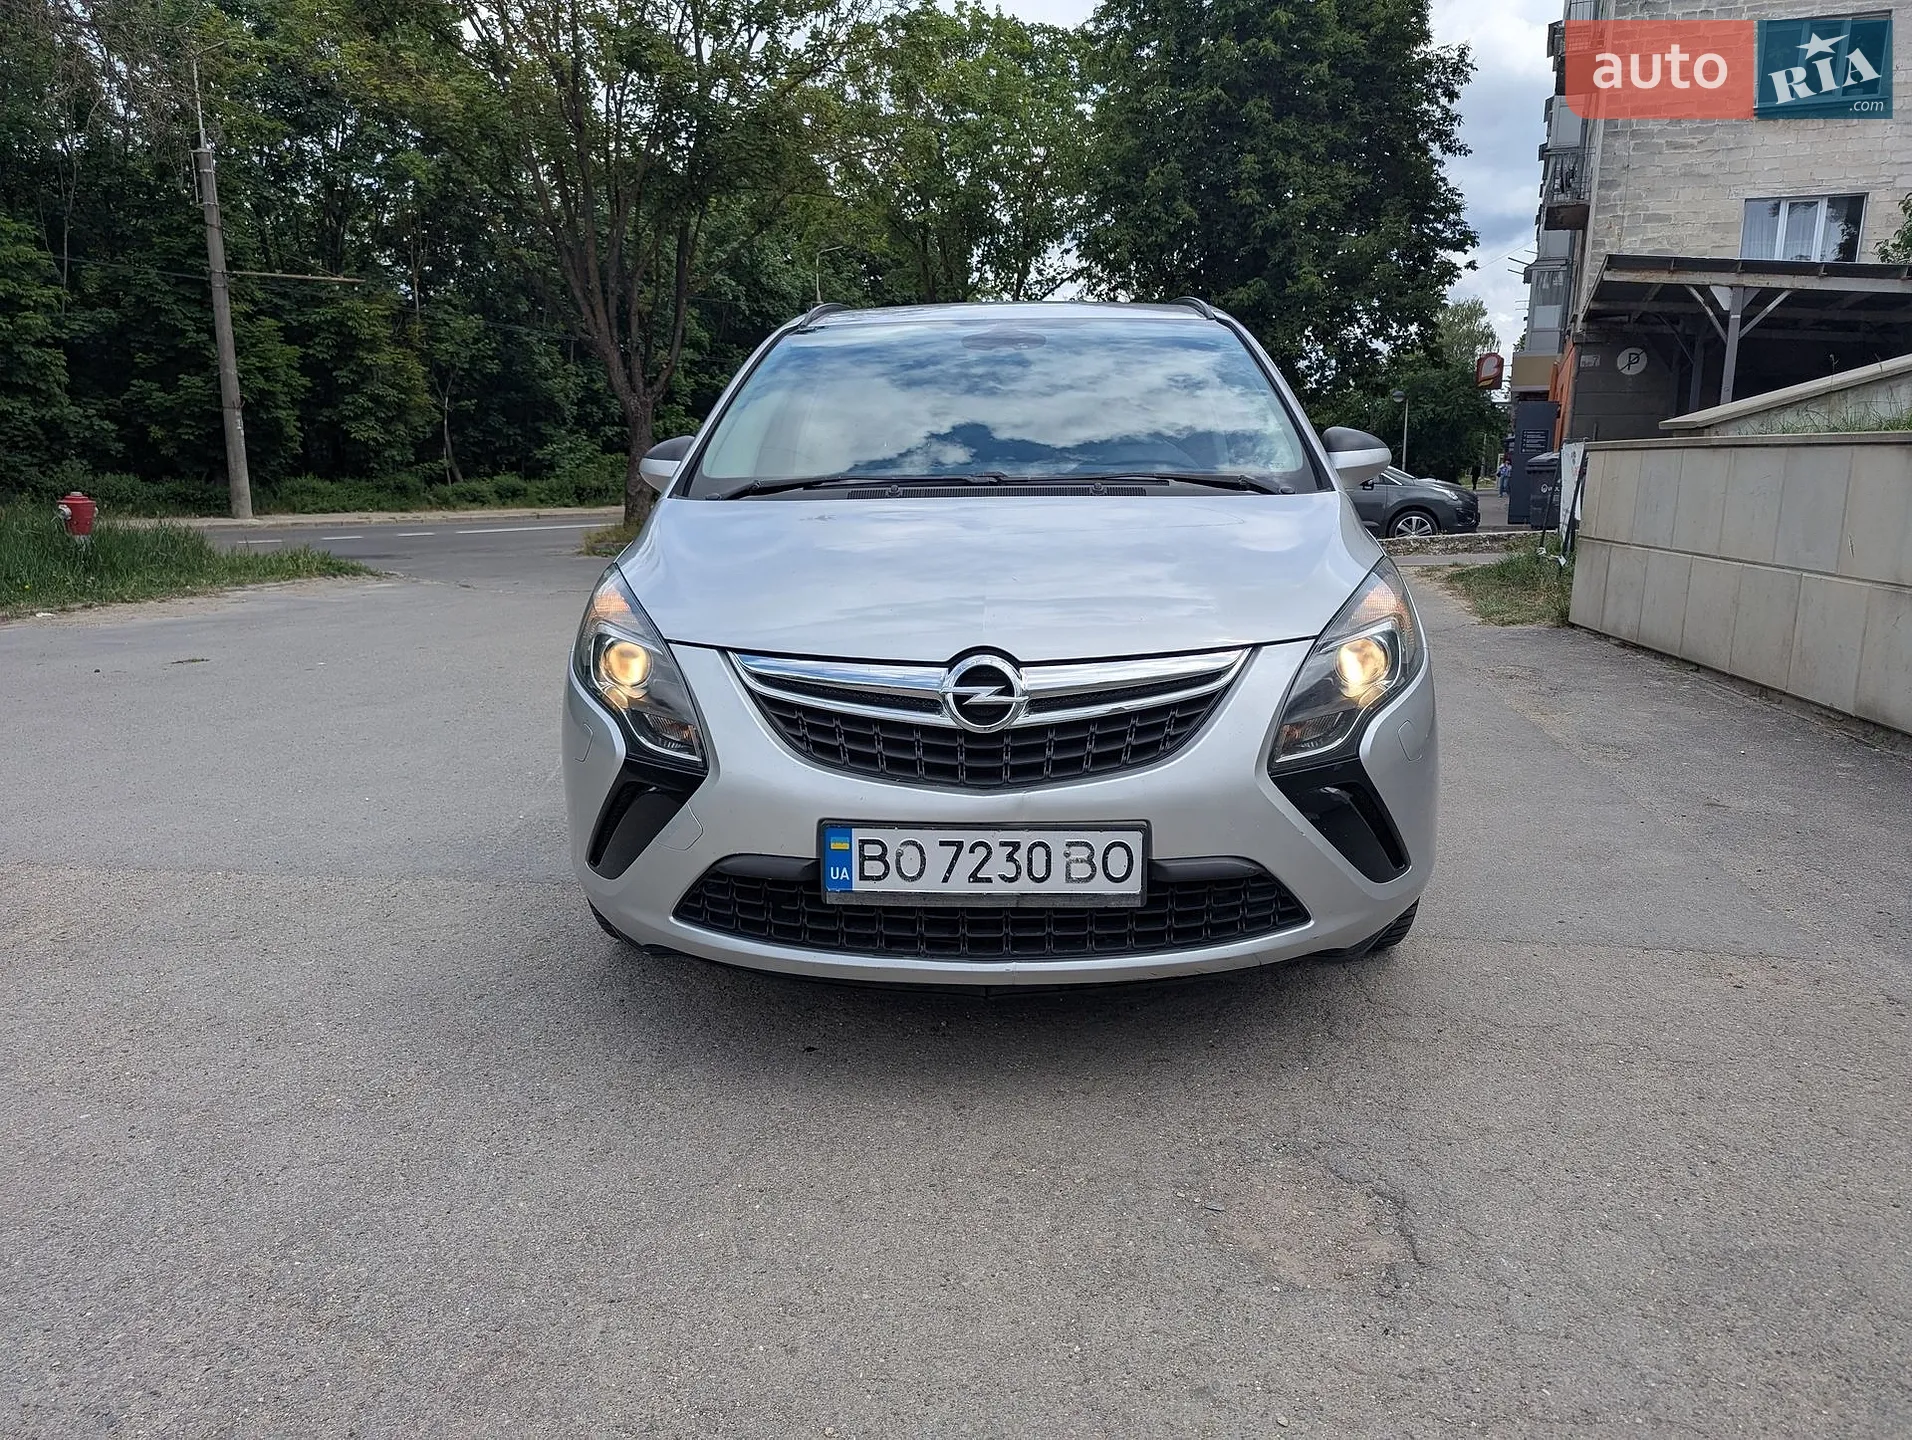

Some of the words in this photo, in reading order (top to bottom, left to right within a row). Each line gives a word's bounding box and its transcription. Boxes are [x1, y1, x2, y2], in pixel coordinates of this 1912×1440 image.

[830, 866, 850, 881] UA
[858, 838, 927, 883] BO
[938, 839, 1053, 884] 7230
[1064, 839, 1135, 884] BO
